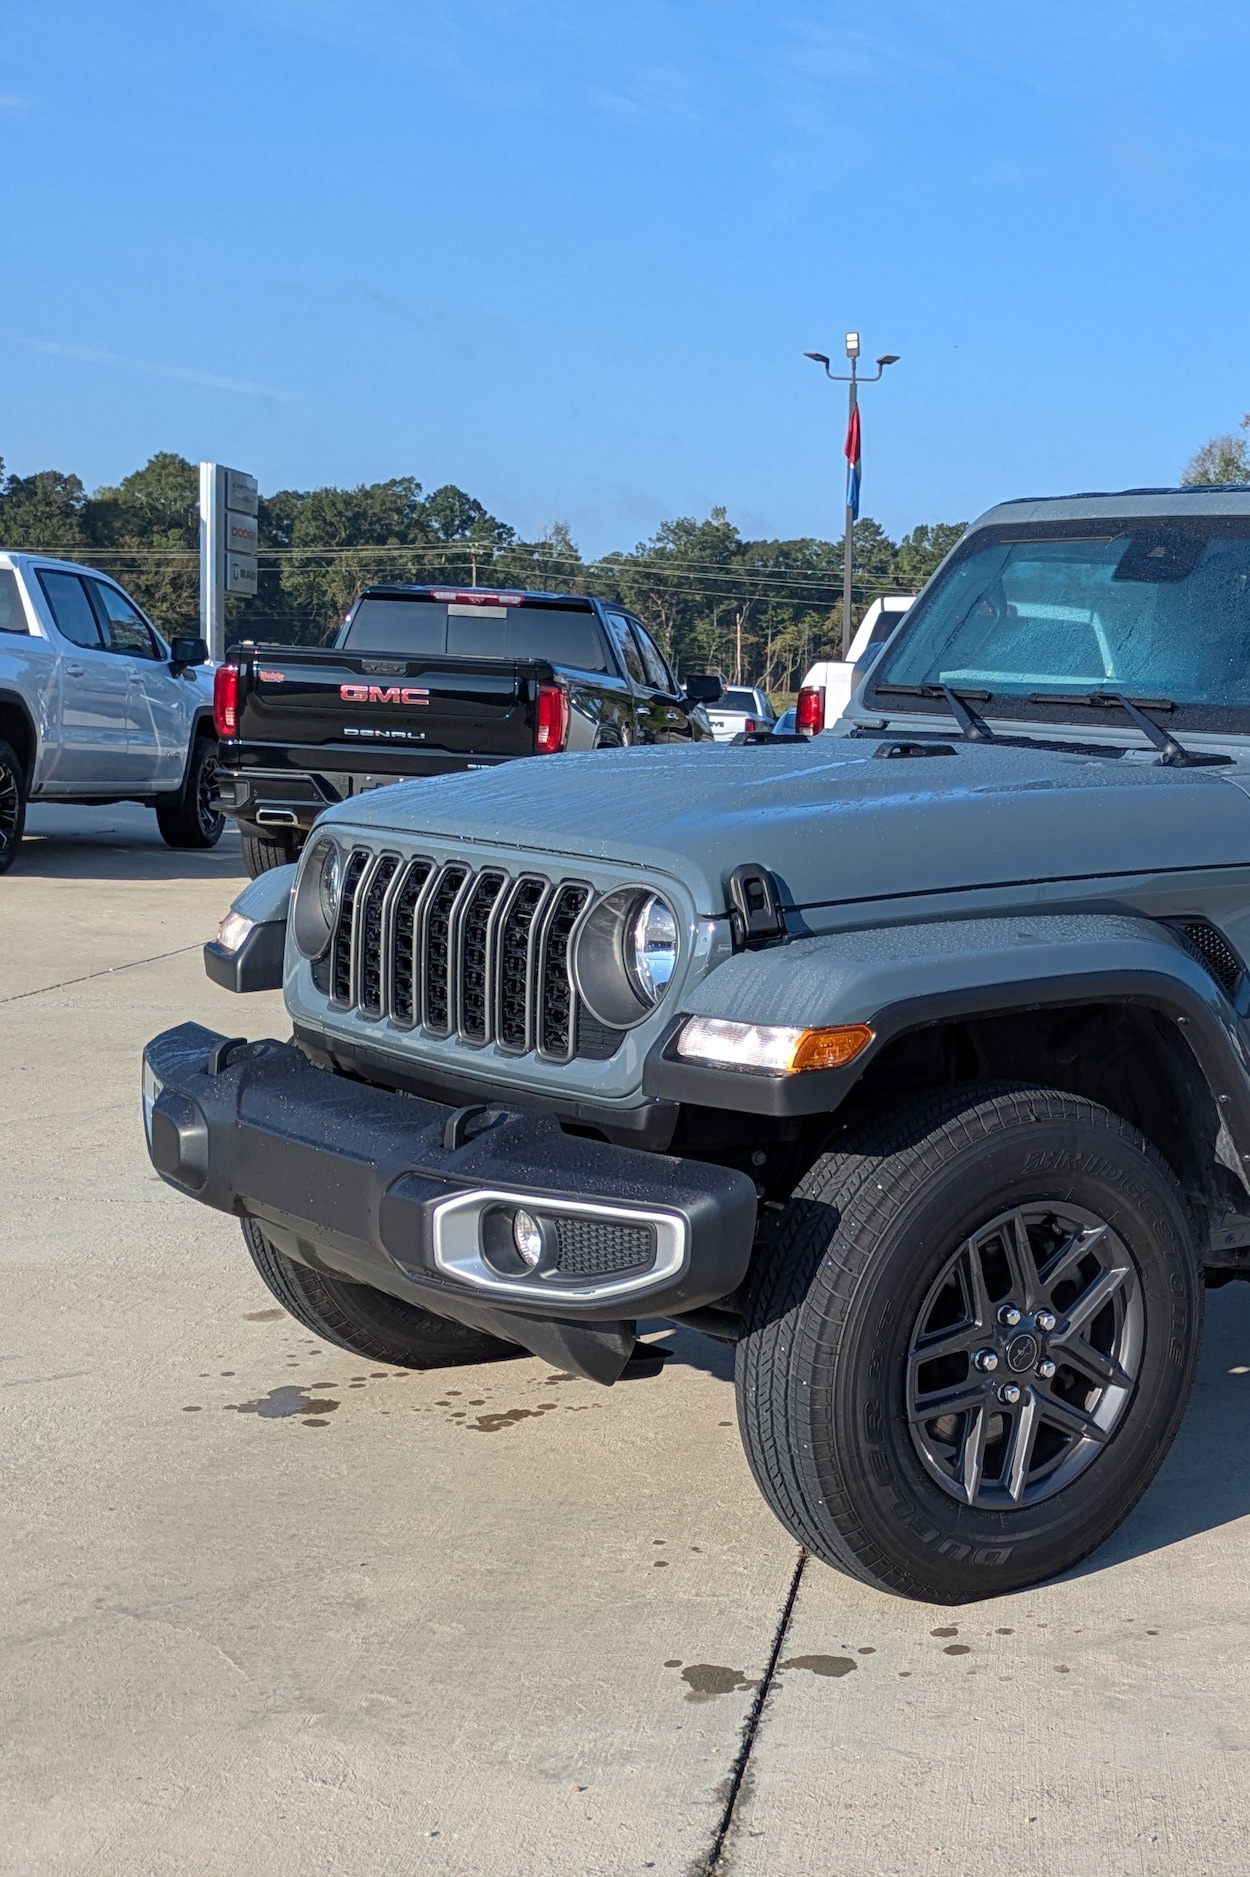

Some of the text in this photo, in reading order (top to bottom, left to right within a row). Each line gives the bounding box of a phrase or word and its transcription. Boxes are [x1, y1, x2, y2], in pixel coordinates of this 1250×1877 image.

[231, 526, 257, 541] DODGE
[340, 684, 430, 705] GMC
[343, 728, 426, 740] DENALI
[1021, 1149, 1189, 1368] BRIDGESTONE
